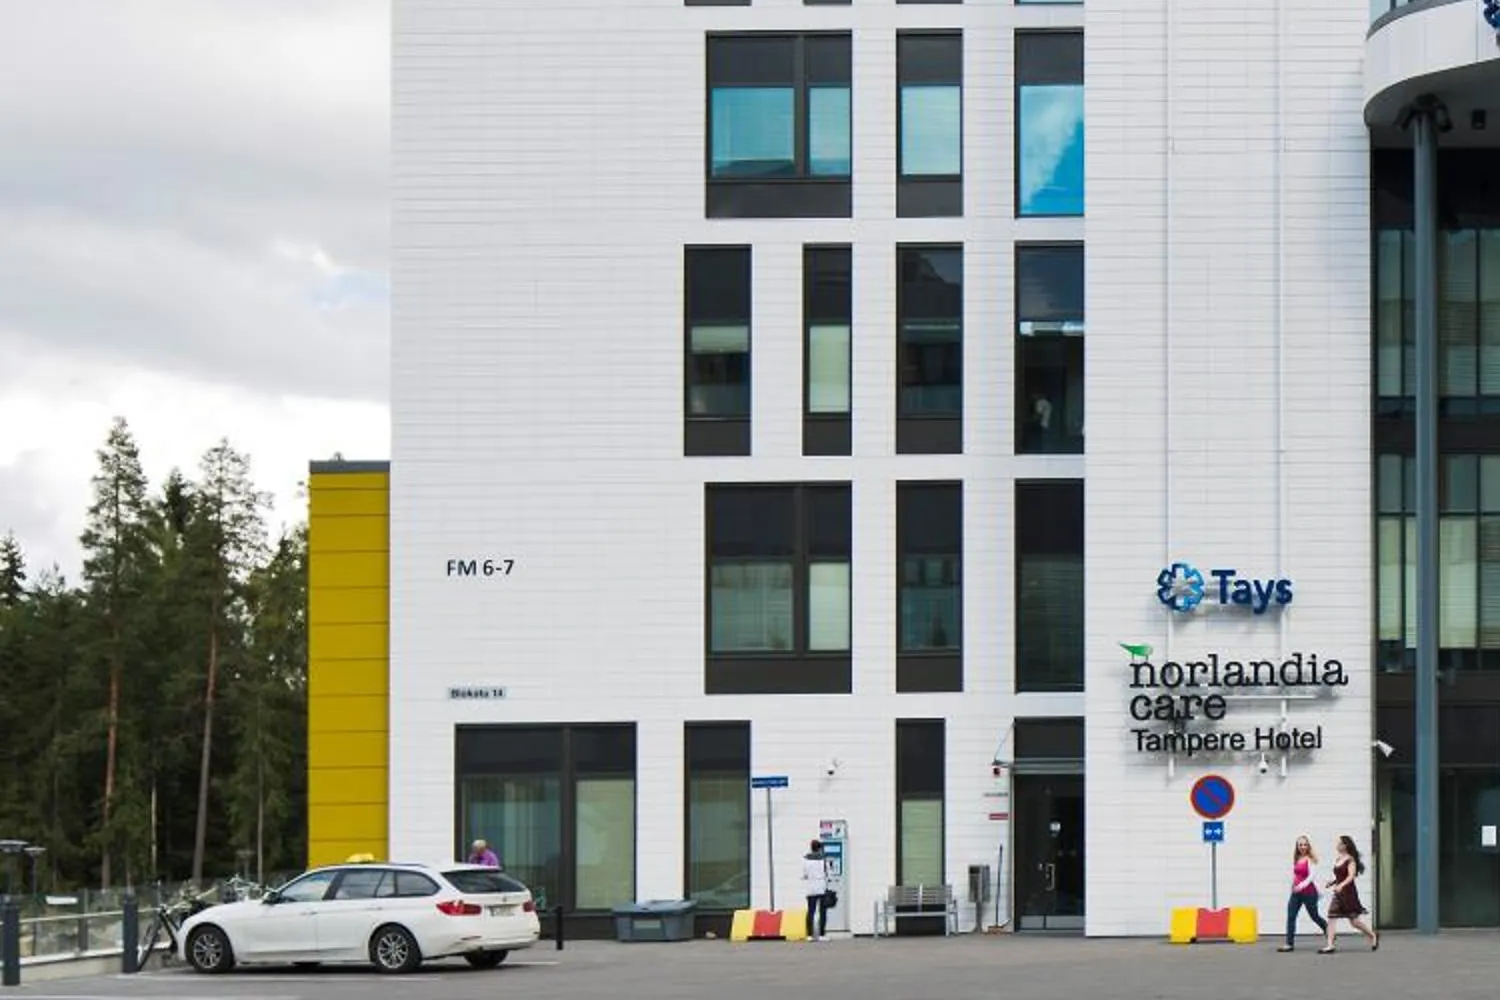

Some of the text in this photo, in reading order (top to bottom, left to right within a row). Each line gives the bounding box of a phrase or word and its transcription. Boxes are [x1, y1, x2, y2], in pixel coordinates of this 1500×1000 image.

[447, 559, 515, 577] FM 6-7
[1211, 568, 1294, 614] Tays
[1129, 652, 1349, 689] norlandia
[1129, 693, 1227, 721] care
[1131, 725, 1323, 757] Tampere Hotel
